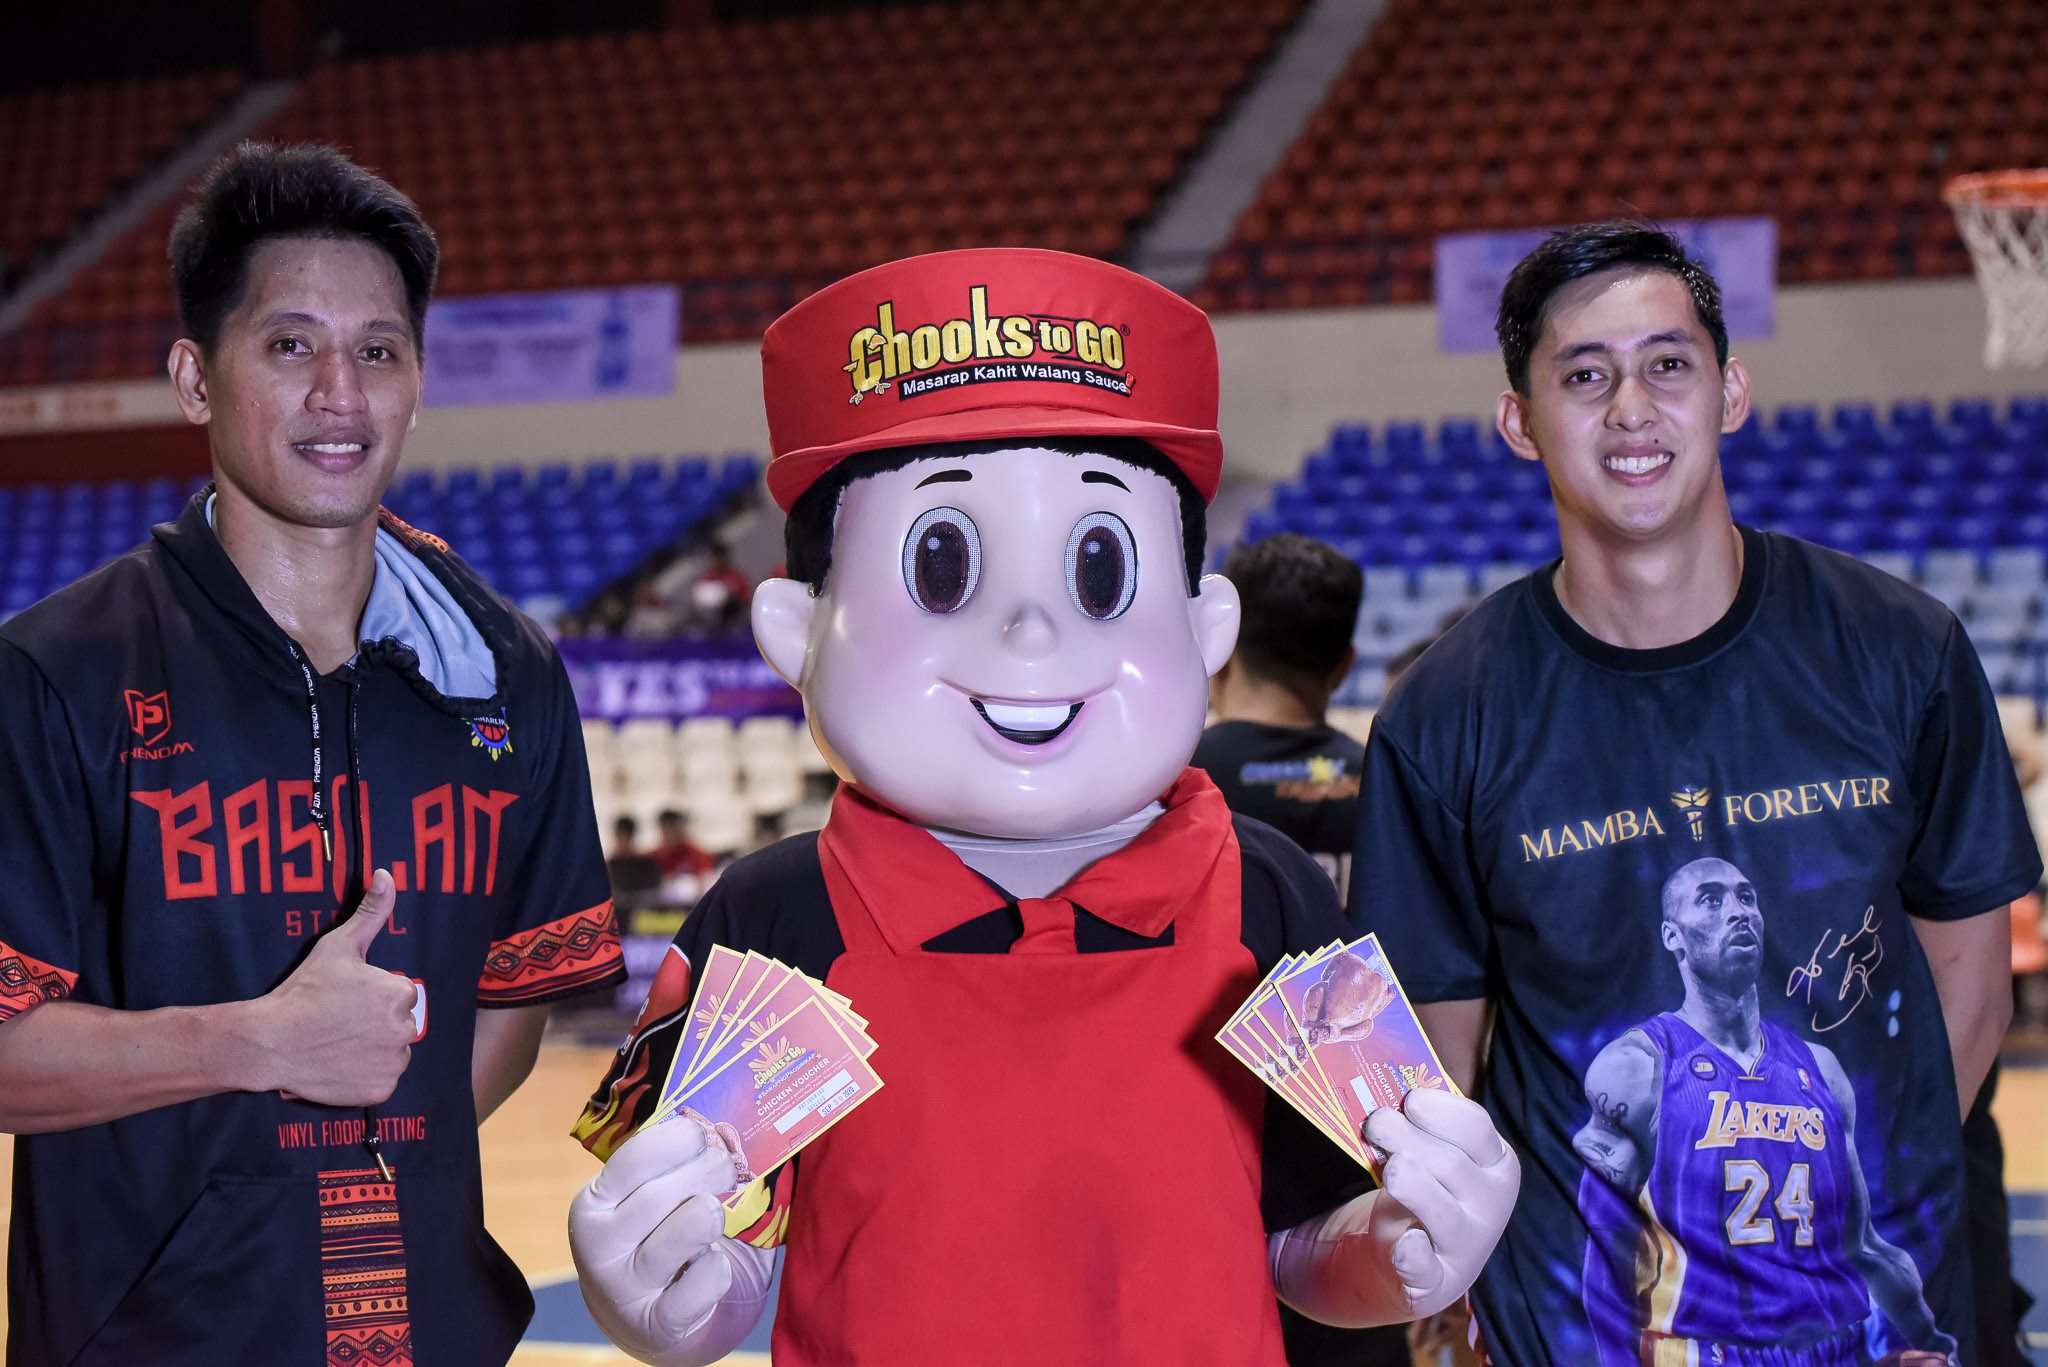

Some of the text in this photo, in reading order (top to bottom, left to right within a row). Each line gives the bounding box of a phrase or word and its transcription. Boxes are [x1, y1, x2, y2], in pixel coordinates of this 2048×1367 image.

[849, 285, 1034, 394] Chooks
[1038, 319, 1072, 354] to
[903, 370, 969, 396] Masarap
[974, 364, 1017, 381] Kahit
[1021, 364, 1081, 383] Walang
[313, 747, 321, 783] PHENOM
[1520, 777, 1893, 863] MAMBA FOREVER
[285, 910, 407, 937] STL
[757, 1086, 793, 1116] CHICKEN
[792, 1057, 830, 1088] VOUCHER
[1372, 1062, 1396, 1101] CHICKEN
[821, 1104, 832, 1115] SEP
[1695, 1090, 1826, 1150] LAKERS
[278, 1122, 317, 1149] VINYL
[1724, 1159, 1814, 1246] 24
